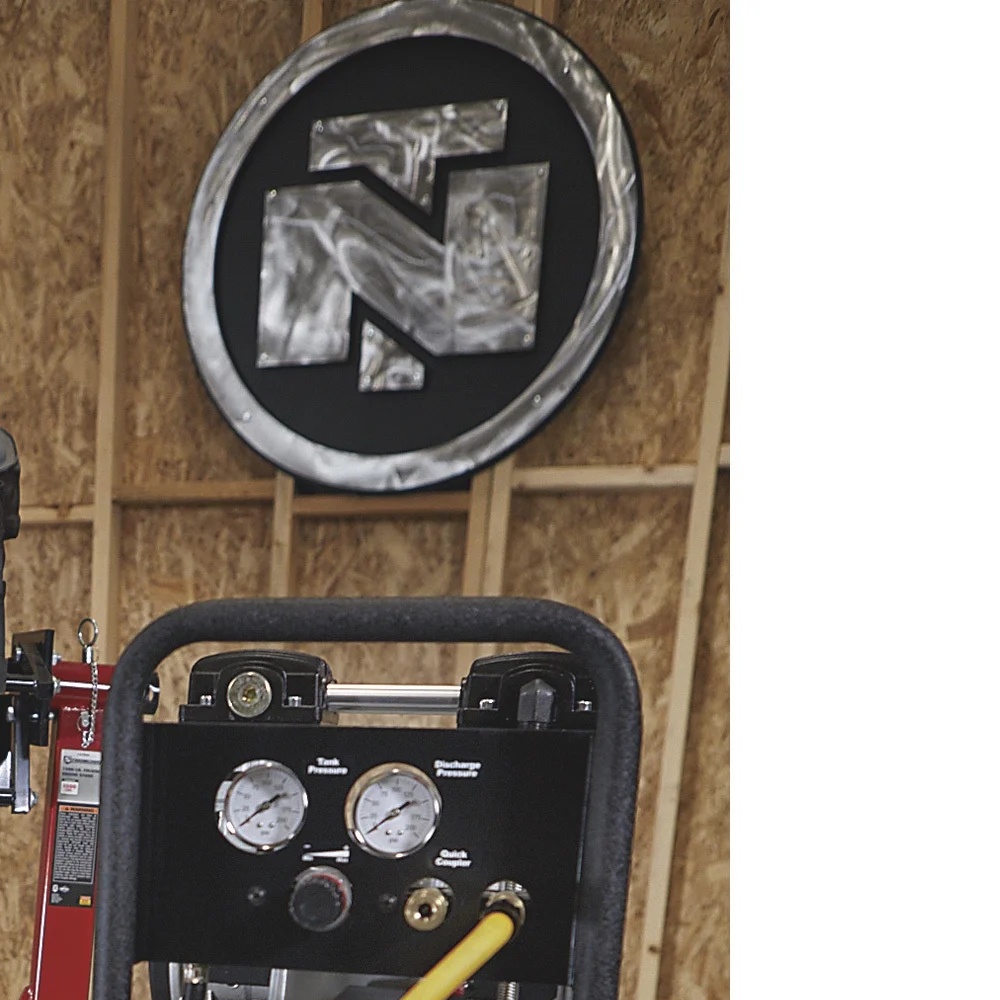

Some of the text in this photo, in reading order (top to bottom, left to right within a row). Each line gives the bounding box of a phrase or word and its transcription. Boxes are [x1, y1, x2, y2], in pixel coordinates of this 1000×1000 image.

[316, 757, 340, 767] Tank
[433, 760, 482, 771] Discharge
[307, 765, 348, 775] Pressure
[435, 768, 479, 779] Pressure
[439, 849, 468, 859] Quick
